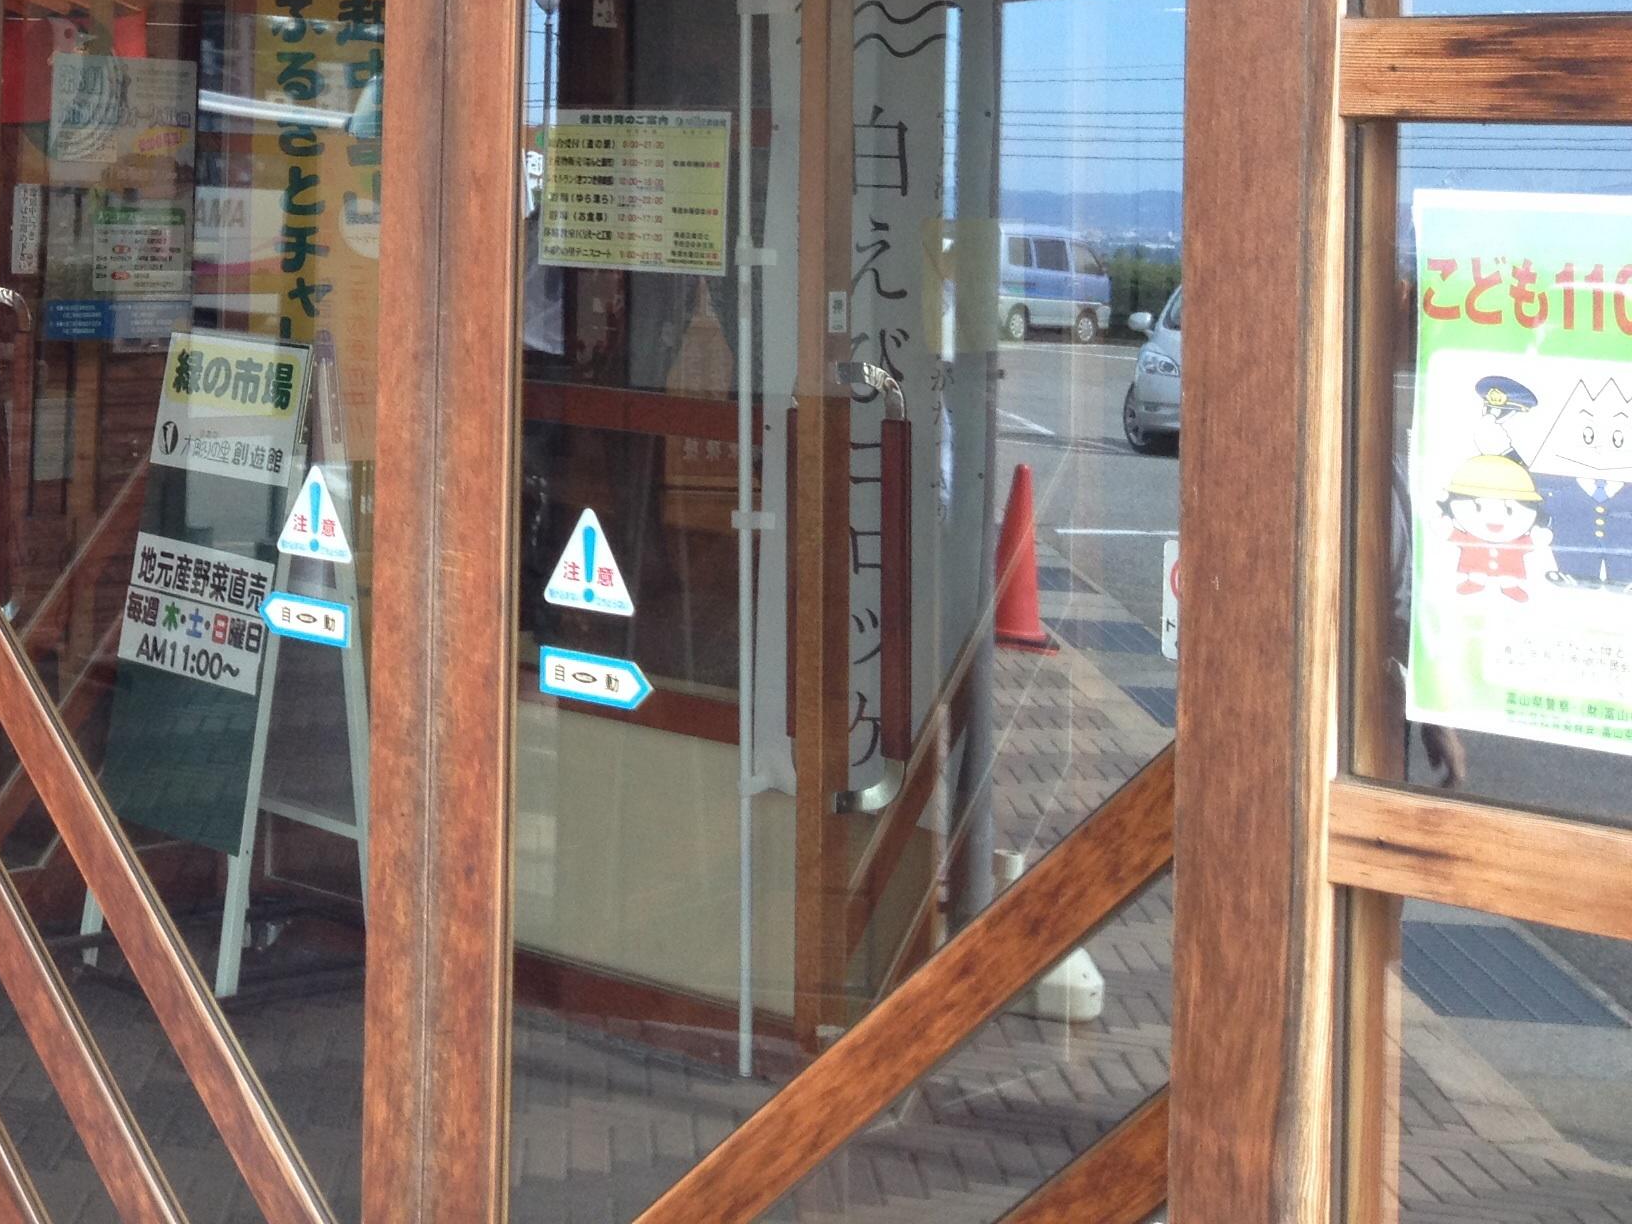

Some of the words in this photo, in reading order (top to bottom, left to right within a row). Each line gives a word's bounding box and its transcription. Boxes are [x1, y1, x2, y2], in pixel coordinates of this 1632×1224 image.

[172, 348, 294, 410] 緑の市場
[293, 514, 336, 537] 注意
[137, 545, 268, 612] 地元産野菜直売
[563, 561, 614, 587] 注意
